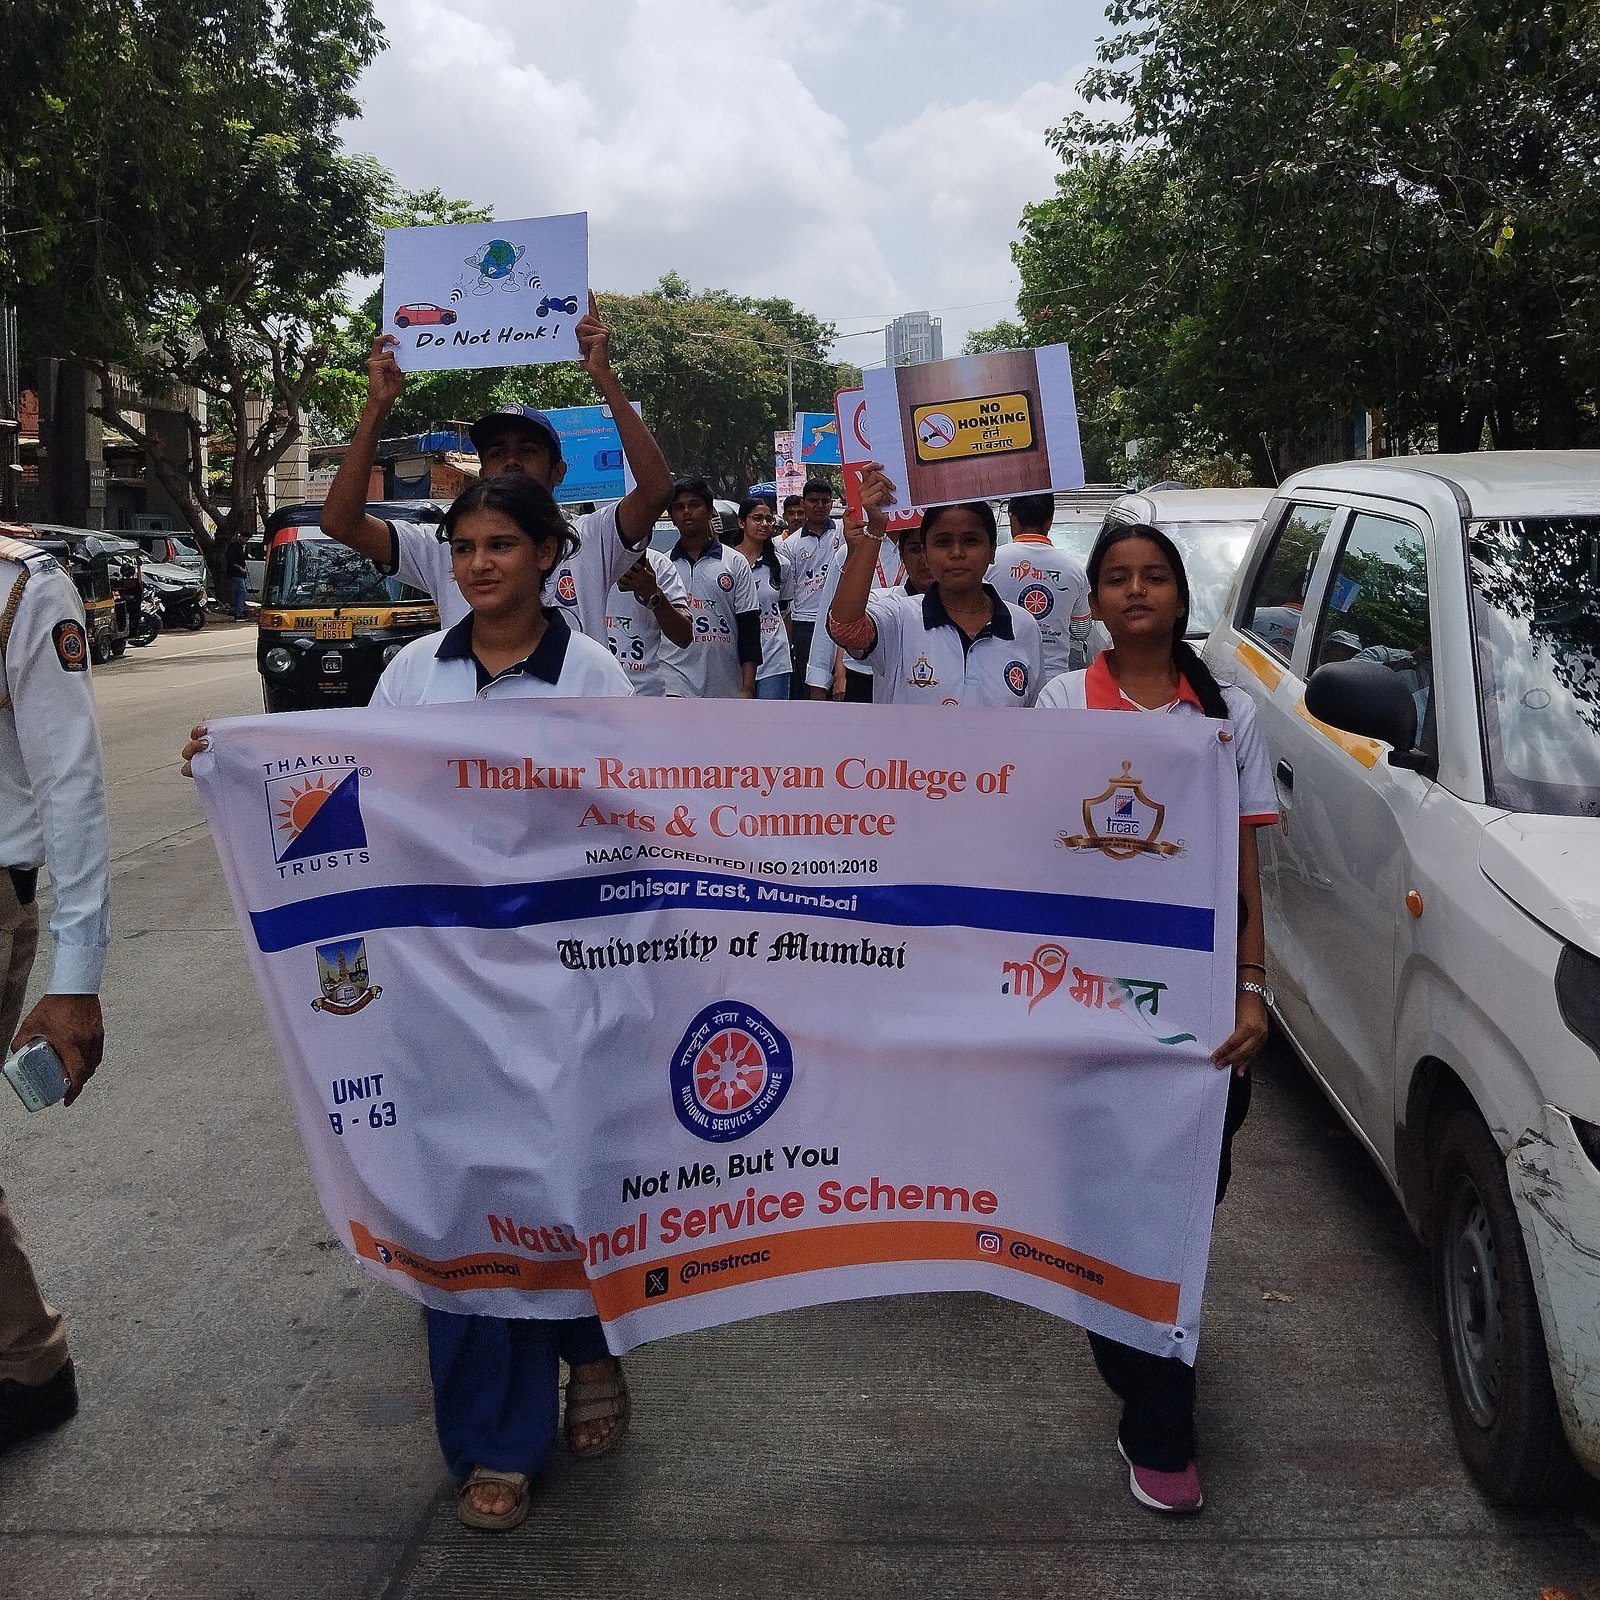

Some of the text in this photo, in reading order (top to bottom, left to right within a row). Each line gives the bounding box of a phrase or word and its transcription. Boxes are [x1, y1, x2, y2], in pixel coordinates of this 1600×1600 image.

[415, 332, 446, 349] Do
[452, 328, 491, 346] Not
[497, 325, 548, 344] Honk
[957, 411, 1026, 430] HONKING
[979, 402, 1001, 415] NO
[970, 442, 982, 451] ना
[981, 426, 1000, 439] हॉर्न
[702, 635, 717, 643] BUT
[628, 662, 645, 671] YOU
[262, 755, 357, 776] THAKUR
[447, 757, 1016, 800] Thakur Ramnarayan College of
[577, 804, 897, 837] Arts & Commerce
[276, 851, 370, 879] TRUSTS
[585, 845, 633, 865] NAAC
[636, 844, 746, 871] ACCREDITED
[758, 861, 787, 875] ISO
[790, 859, 878, 875] 21001:2018
[600, 878, 858, 912] Dahisar East, Mumbai
[557, 929, 908, 972] University of Mumbai
[331, 1073, 384, 1105] UNIT
[681, 1071, 784, 1132] NATIONAL SERVICE SCHEME
[328, 1112, 344, 1136] B
[369, 1101, 398, 1130] 63
[621, 1145, 840, 1205] Not Me, But You
[659, 1186, 806, 1245] Service
[817, 1176, 999, 1215] Scheme
[679, 1248, 771, 1284] @nsstrcac
[1008, 1240, 1105, 1287] @trcacnss
